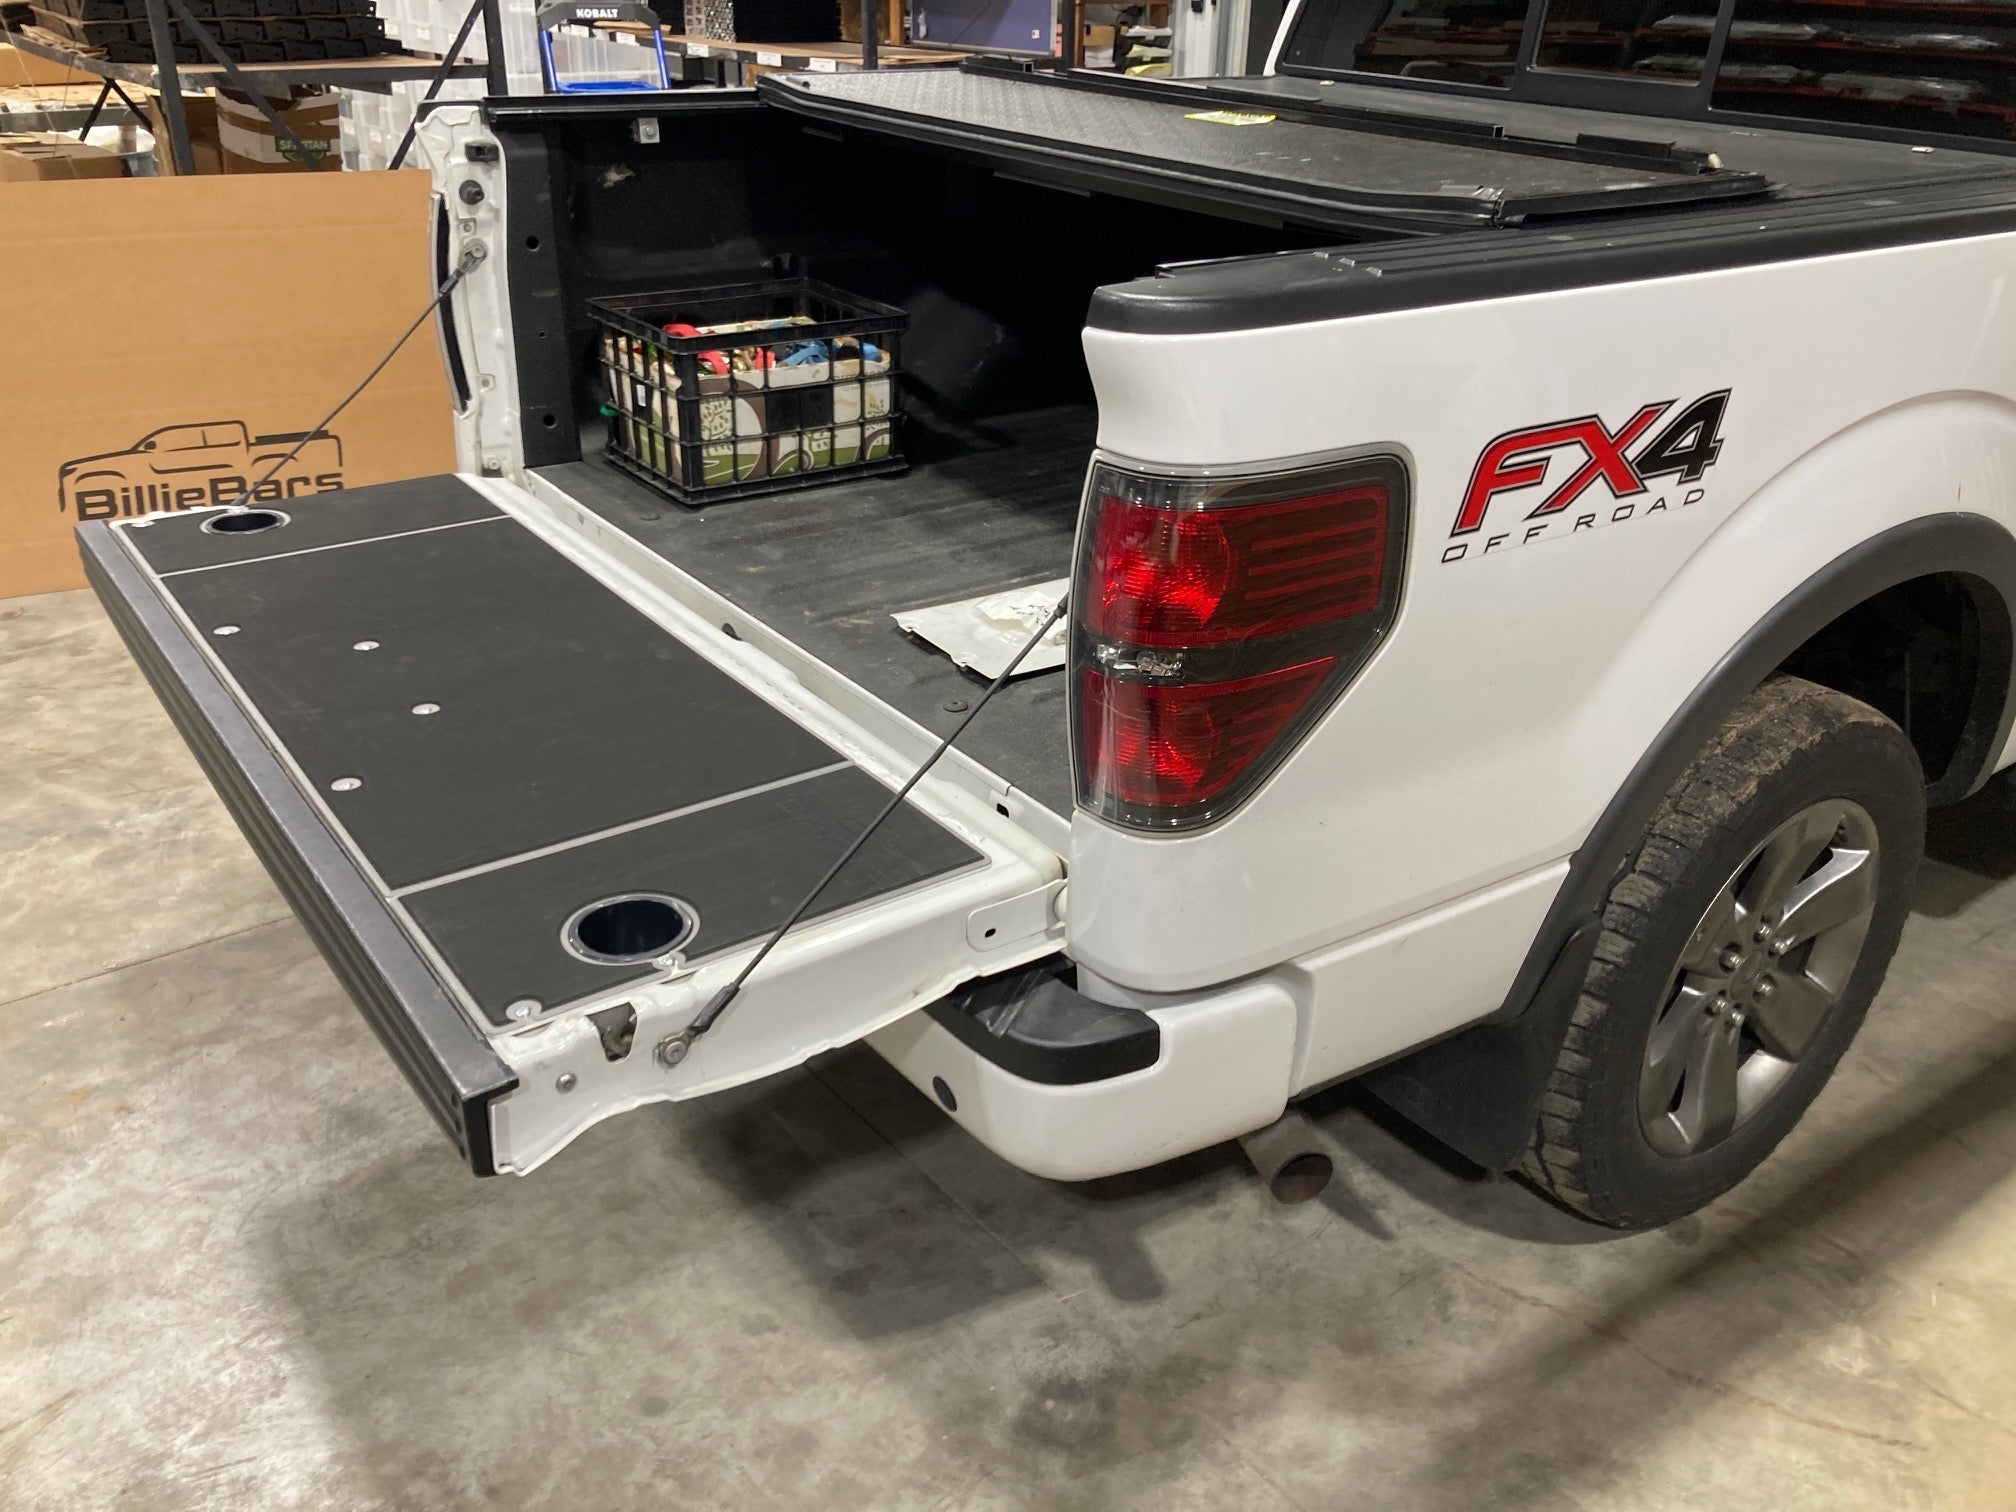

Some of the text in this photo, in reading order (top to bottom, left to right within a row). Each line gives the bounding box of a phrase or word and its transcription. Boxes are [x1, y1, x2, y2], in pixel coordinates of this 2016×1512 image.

[576, 8, 618, 18] KOBALT
[279, 139, 328, 151] SPRTAN
[1449, 387, 1733, 540] FX4
[75, 472, 345, 521] BillieBars
[1441, 488, 1705, 564] OFF ROAD
